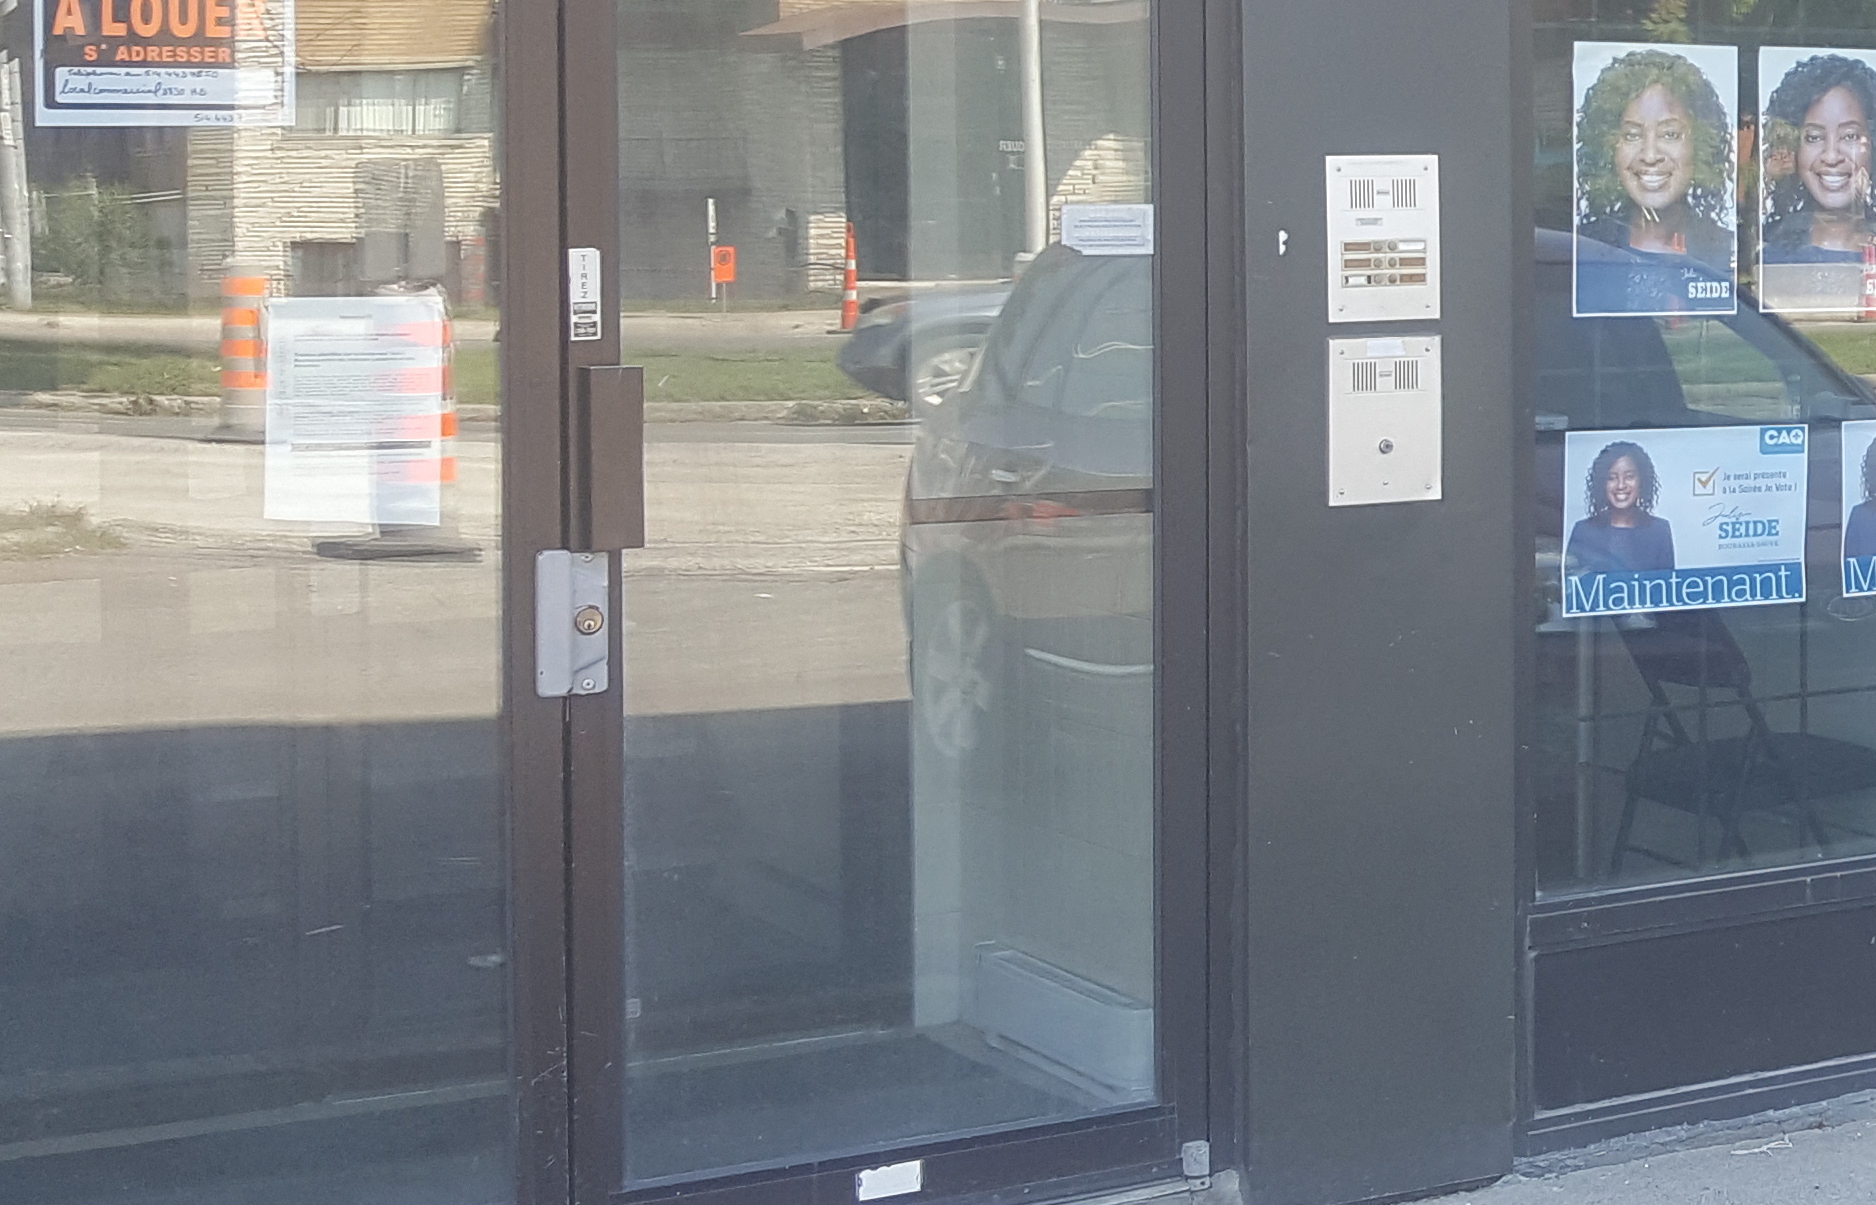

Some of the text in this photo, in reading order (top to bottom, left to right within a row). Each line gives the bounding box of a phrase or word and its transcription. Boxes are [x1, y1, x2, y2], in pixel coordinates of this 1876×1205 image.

[115, 45, 232, 62] ADRESSER
[580, 254, 588, 299] TIREZ
[1764, 428, 1804, 445] CAQ
[1568, 565, 1800, 613] Maintenant.
